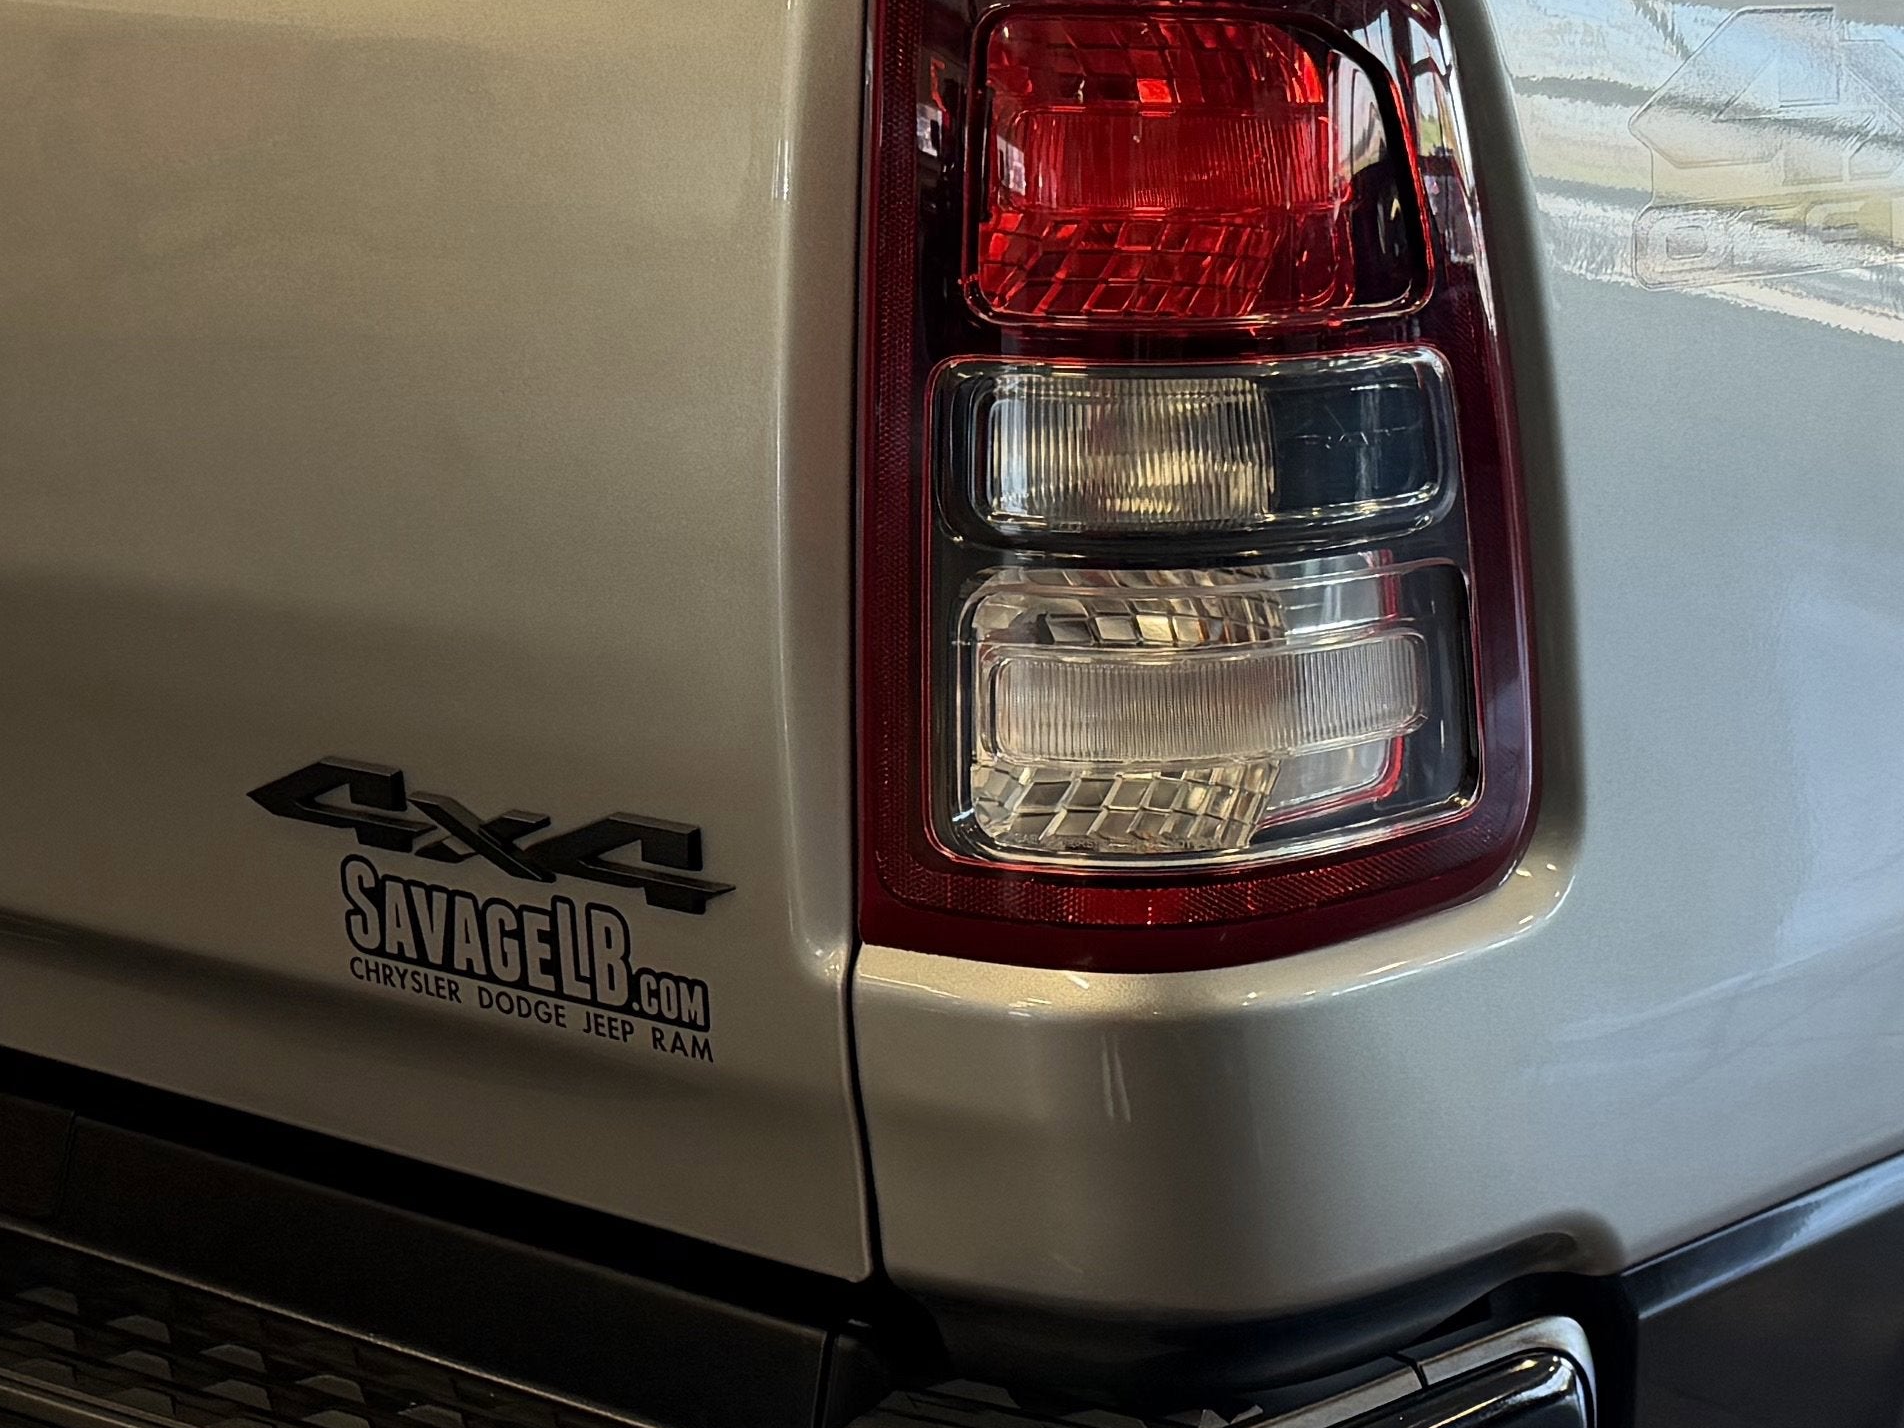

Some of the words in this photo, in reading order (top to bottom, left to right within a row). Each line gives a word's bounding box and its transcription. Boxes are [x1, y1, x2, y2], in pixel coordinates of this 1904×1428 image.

[350, 957, 462, 1003] CHRYSLER
[479, 987, 567, 1029] DODGE
[583, 1011, 635, 1044] JEEP
[652, 1026, 714, 1063] RAM
